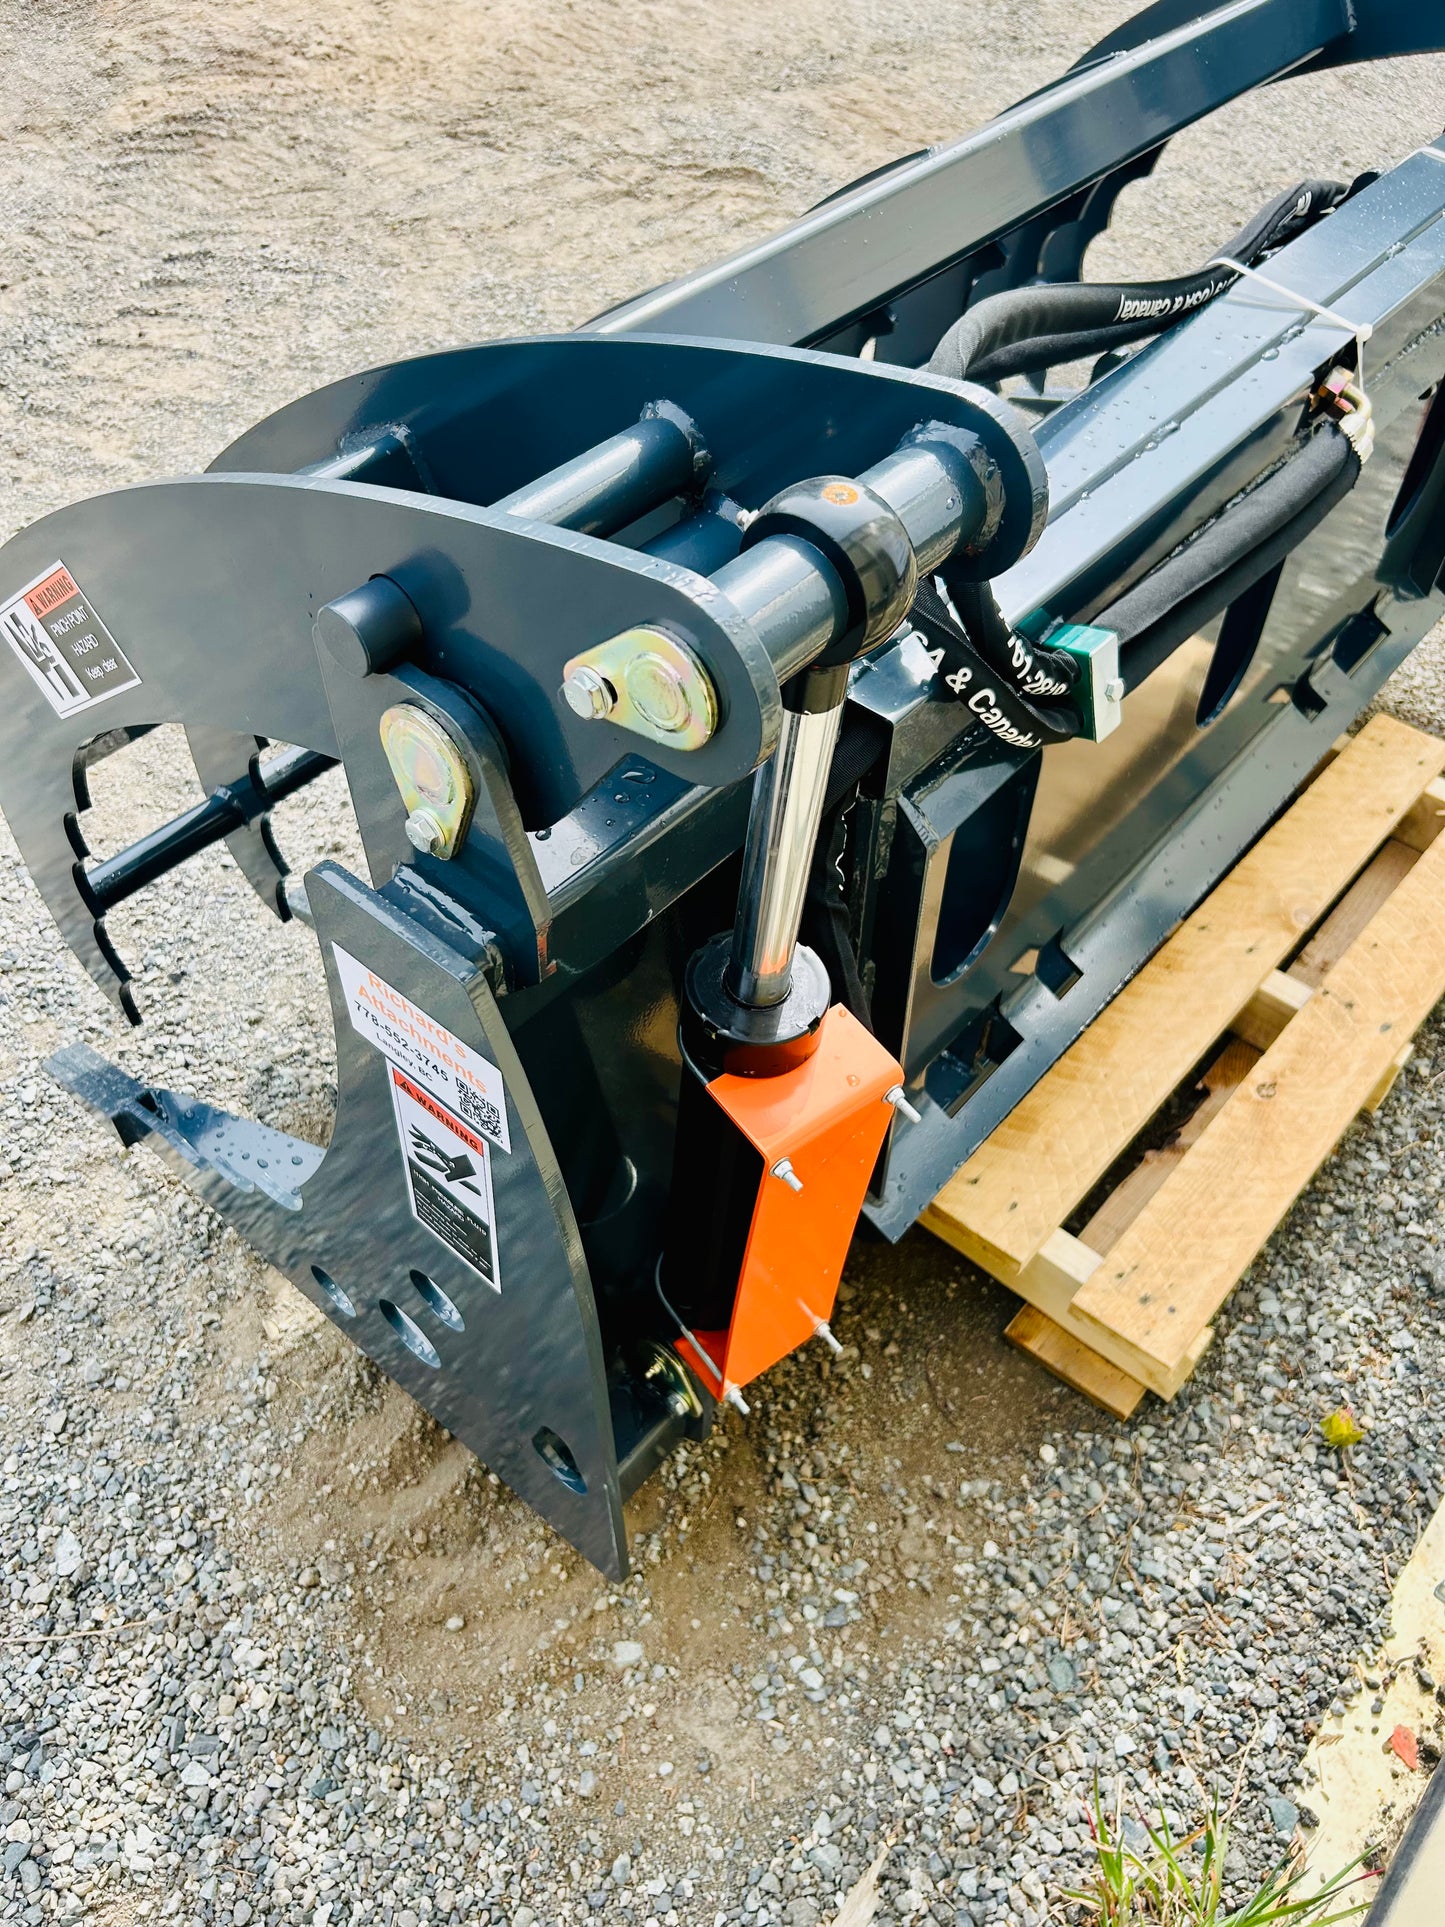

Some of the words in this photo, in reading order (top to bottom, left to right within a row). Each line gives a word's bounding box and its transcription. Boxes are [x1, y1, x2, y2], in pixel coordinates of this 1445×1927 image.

[35, 575, 74, 609] WARNING
[50, 614, 72, 637] PINCH
[69, 605, 89, 629] POINT
[71, 633, 99, 657] HAZARD
[85, 665, 104, 681] Keep
[102, 657, 119, 673] clear
[945, 667, 972, 694] &
[367, 972, 467, 1059] Richard's
[354, 1000, 449, 1082] 778-552-3745
[358, 985, 487, 1093] Attachments
[376, 1032, 416, 1069] Langley,
[418, 1066, 433, 1082] BC
[416, 1095, 479, 1151] WARNING
